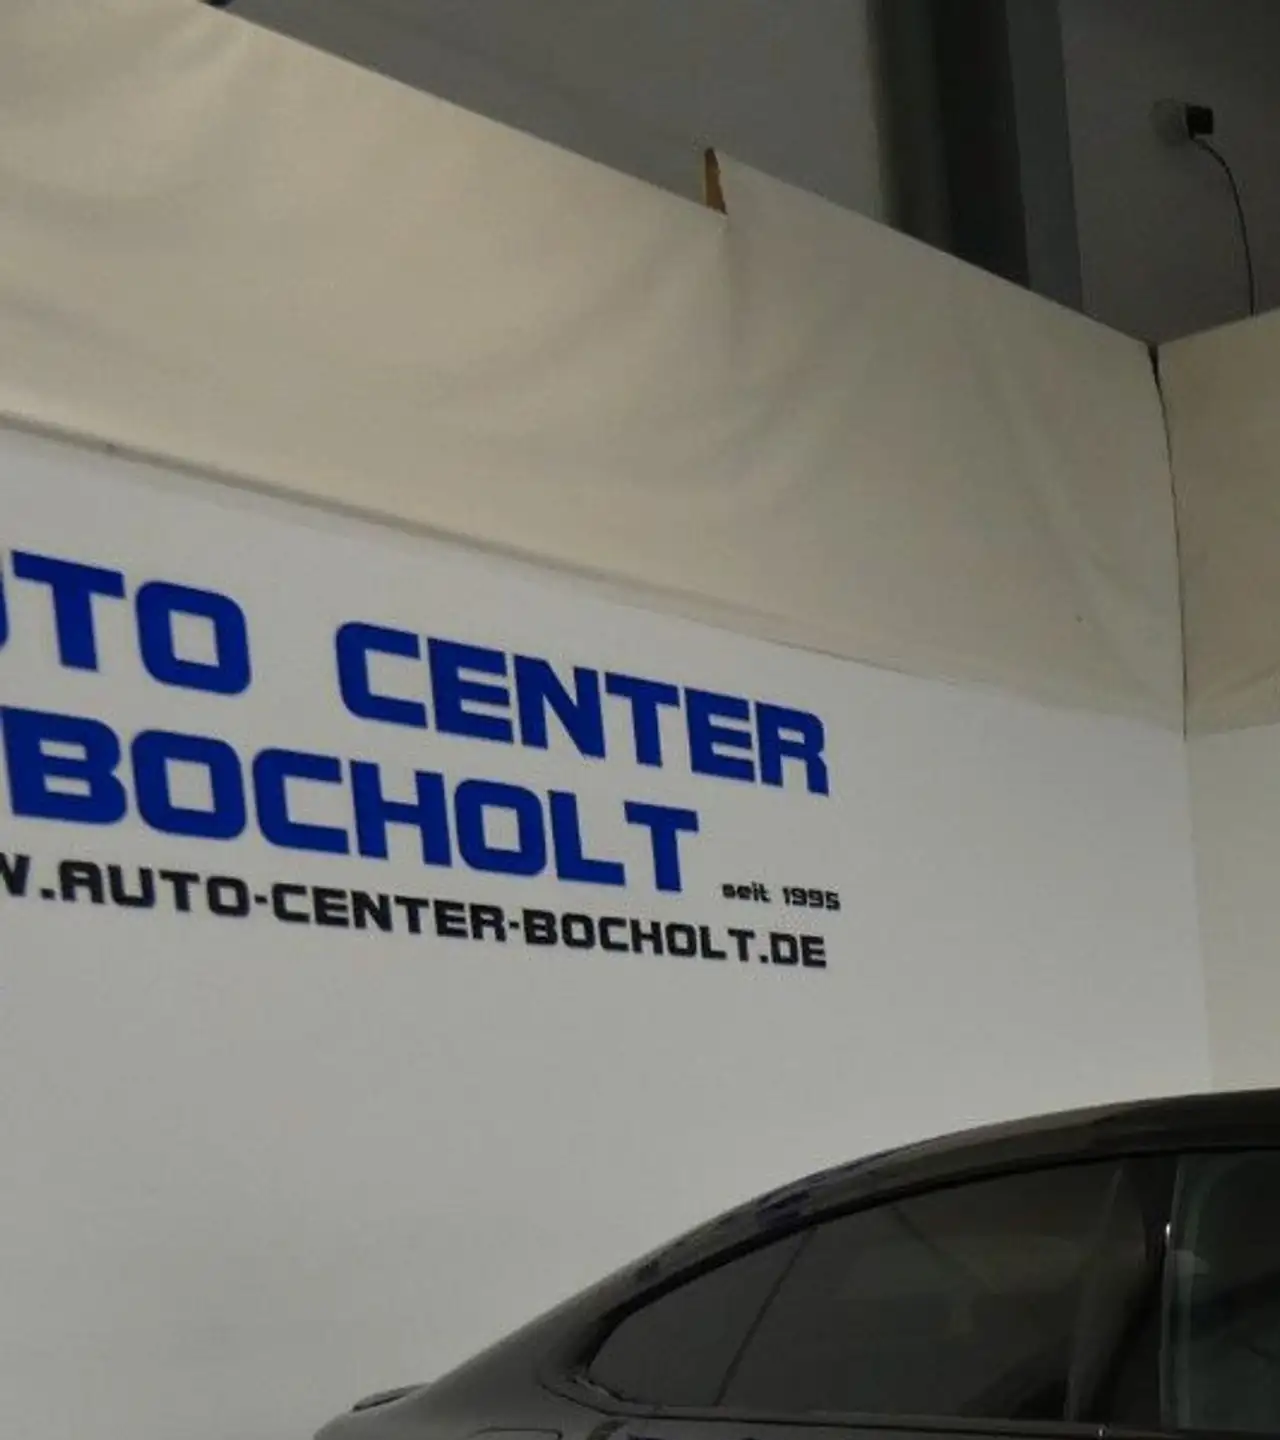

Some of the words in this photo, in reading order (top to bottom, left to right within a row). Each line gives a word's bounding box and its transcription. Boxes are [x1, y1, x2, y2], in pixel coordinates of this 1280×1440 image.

[0, 551, 253, 696] TO
[334, 621, 830, 796] CENTER
[0, 706, 700, 895] BOCHOLT
[722, 881, 771, 903] seit
[782, 886, 841, 911] 1995
